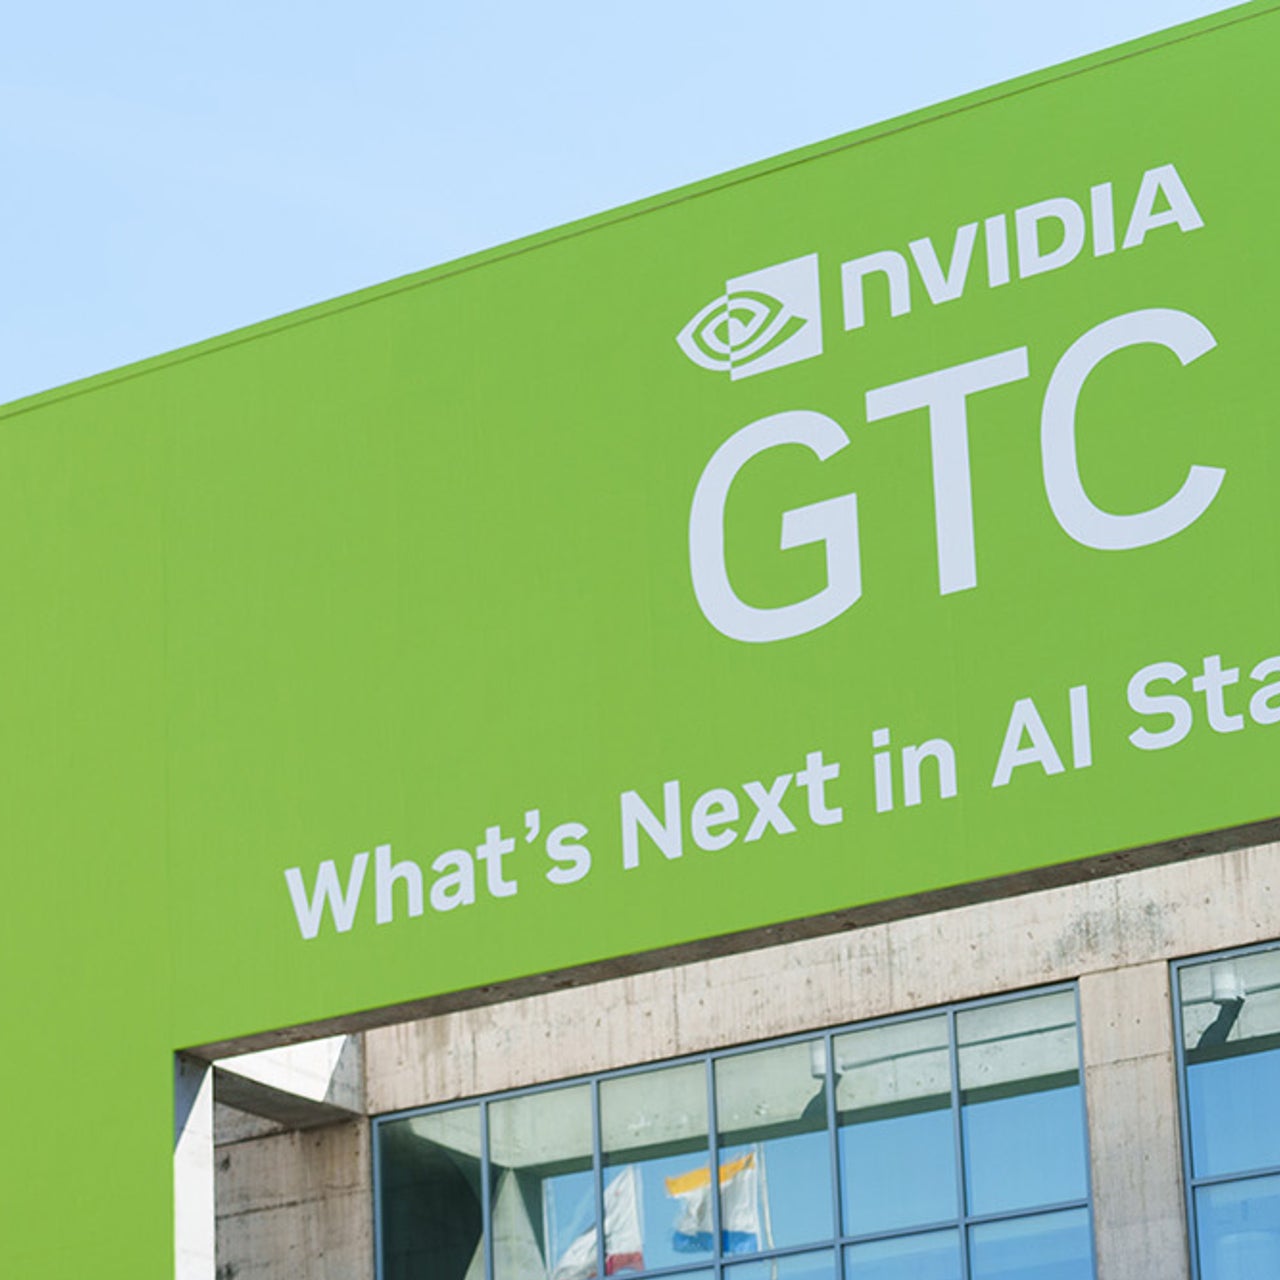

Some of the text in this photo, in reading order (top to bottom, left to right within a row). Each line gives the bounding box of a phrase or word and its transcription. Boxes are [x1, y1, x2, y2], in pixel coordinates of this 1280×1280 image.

[688, 308, 1226, 643] GTC
[285, 810, 591, 940] What’s
[621, 750, 843, 870] Next
[872, 727, 958, 813] in
[991, 684, 1092, 788] AI
